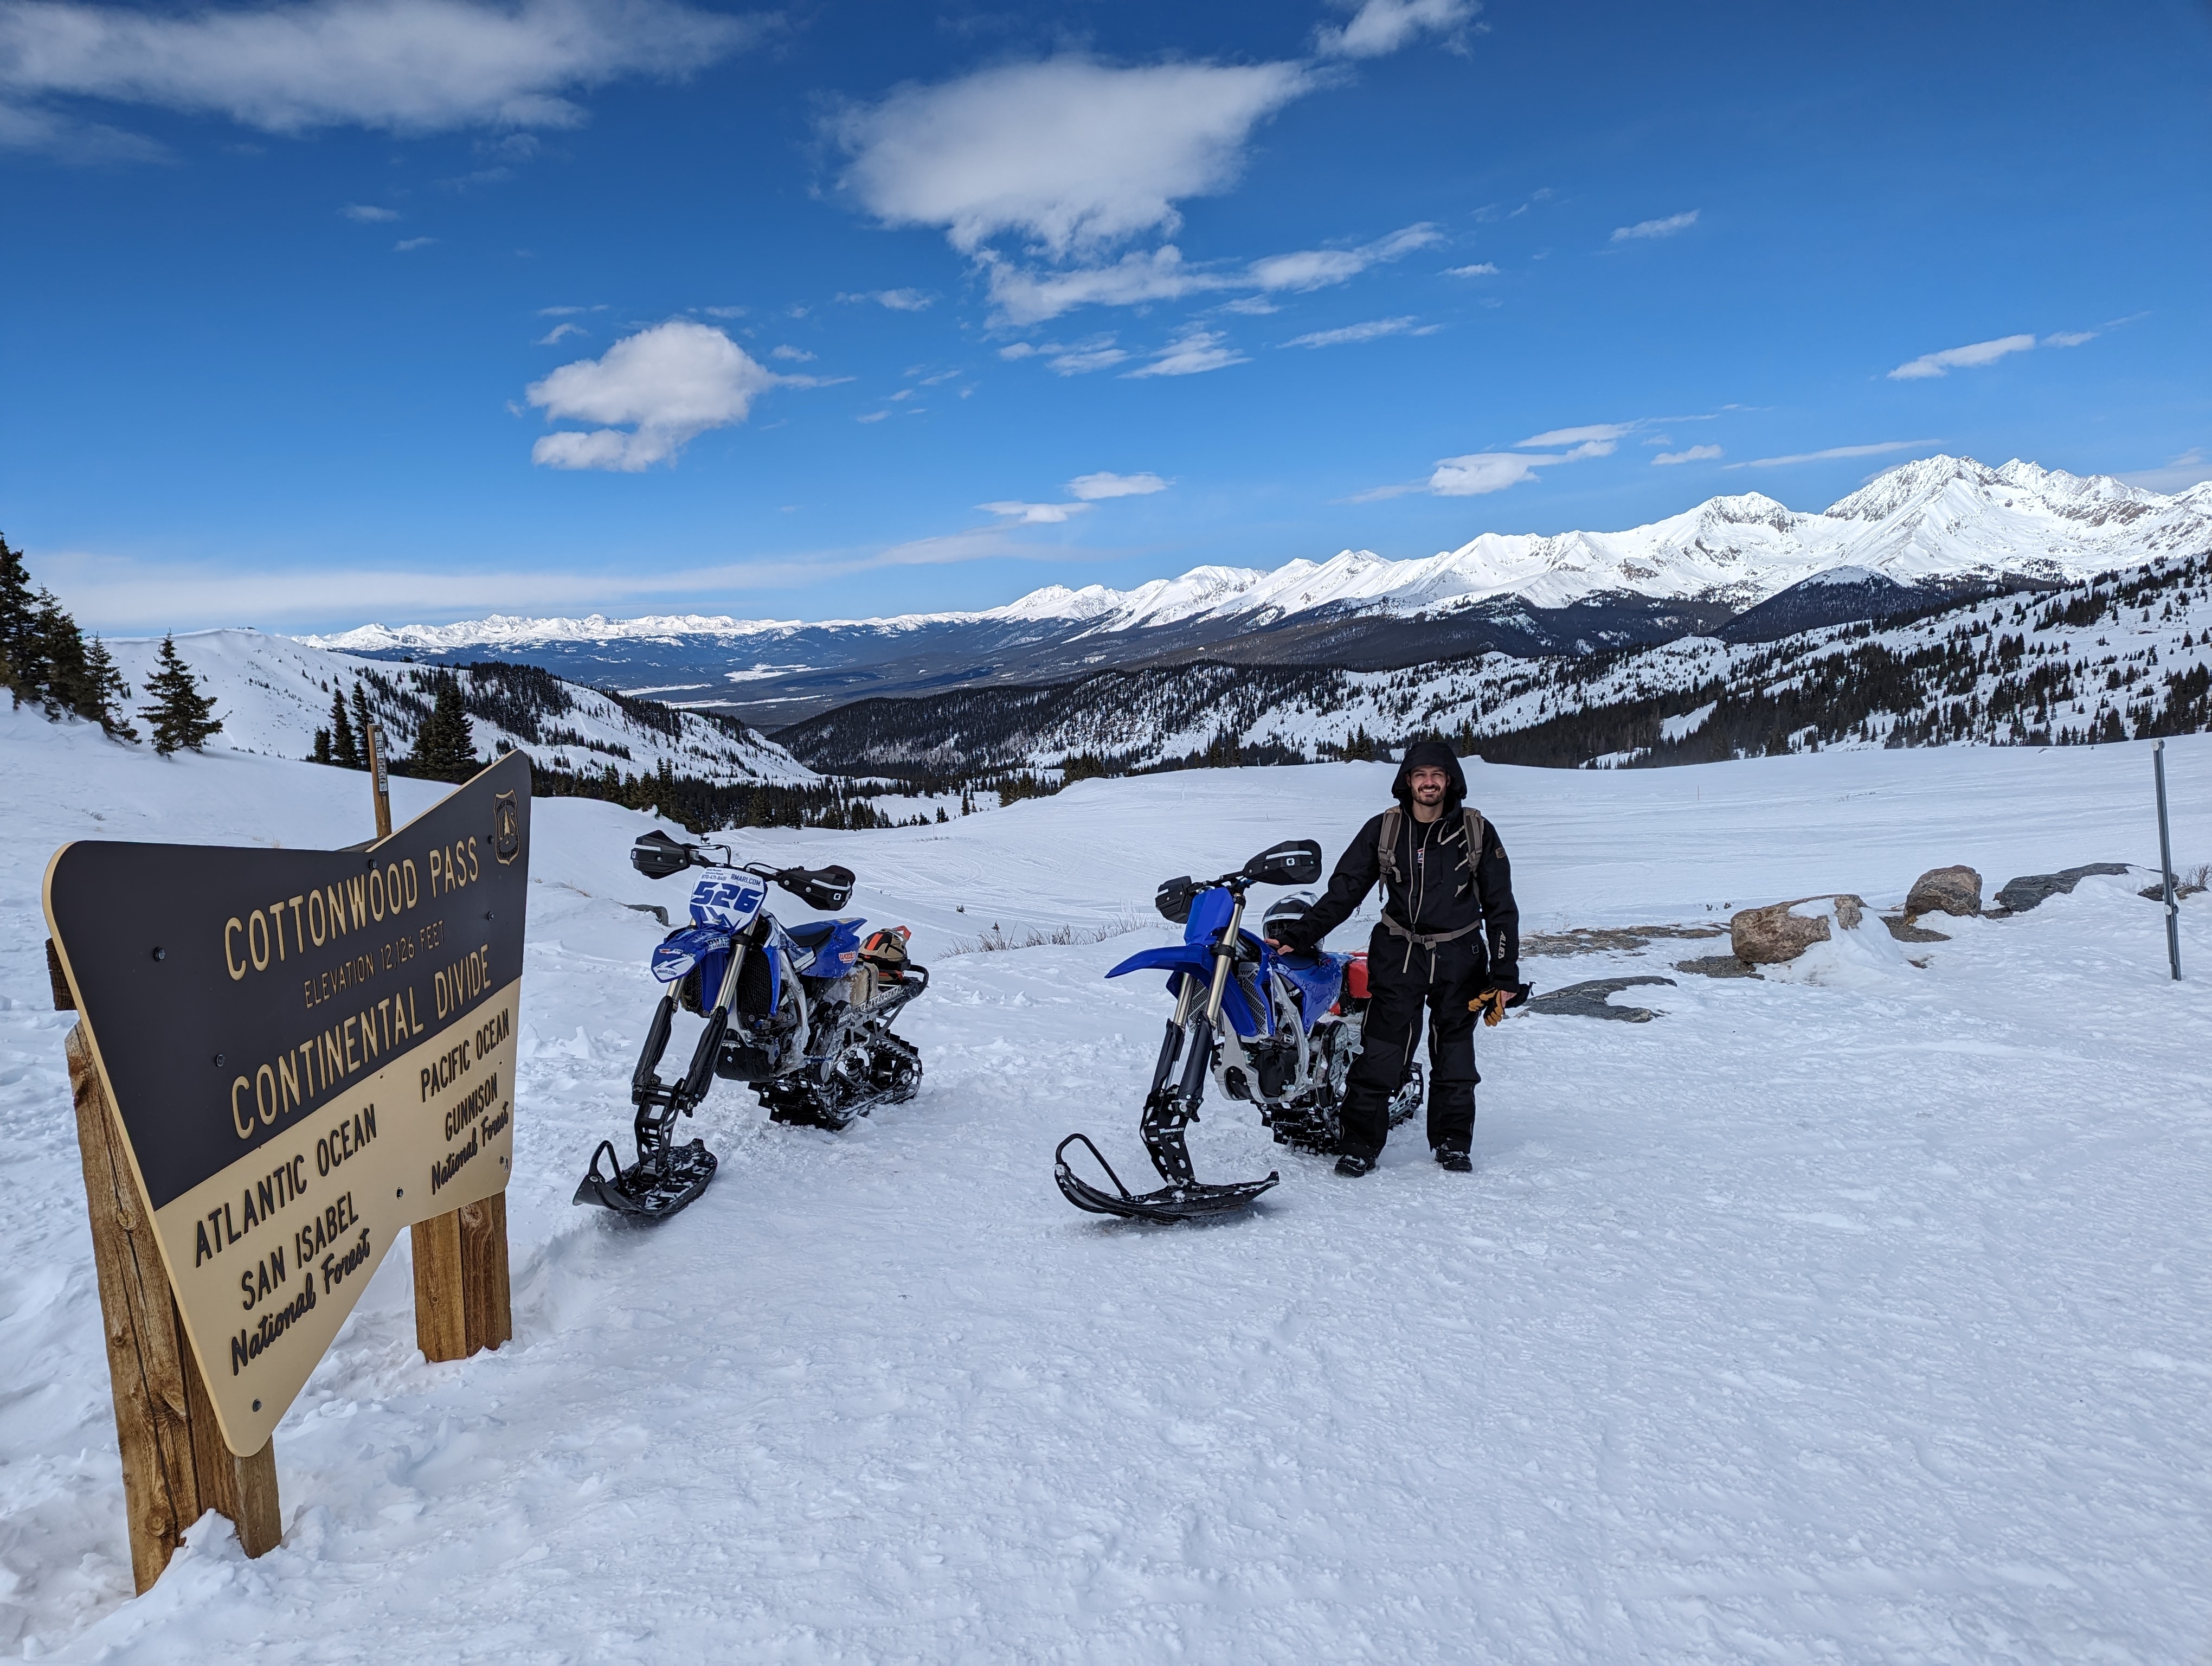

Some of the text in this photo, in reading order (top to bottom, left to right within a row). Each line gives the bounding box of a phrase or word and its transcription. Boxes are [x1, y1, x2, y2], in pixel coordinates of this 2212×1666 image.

[224, 836, 479, 981] COTTONWOOD PASS
[690, 881, 764, 914] 526
[304, 920, 445, 1009] ELEVATION 12,126 FEET
[231, 944, 492, 1140] CONTINENTAL DIVIDE
[420, 1008, 510, 1103] PACIFIC OCEAN
[432, 1100, 510, 1196] National Forest
[445, 1072, 499, 1142] GUNNISON
[195, 1104, 377, 1268] ATLANTIC OCEAN
[231, 1228, 371, 1376] National Forest
[241, 1191, 359, 1311] SAN ISABEL
